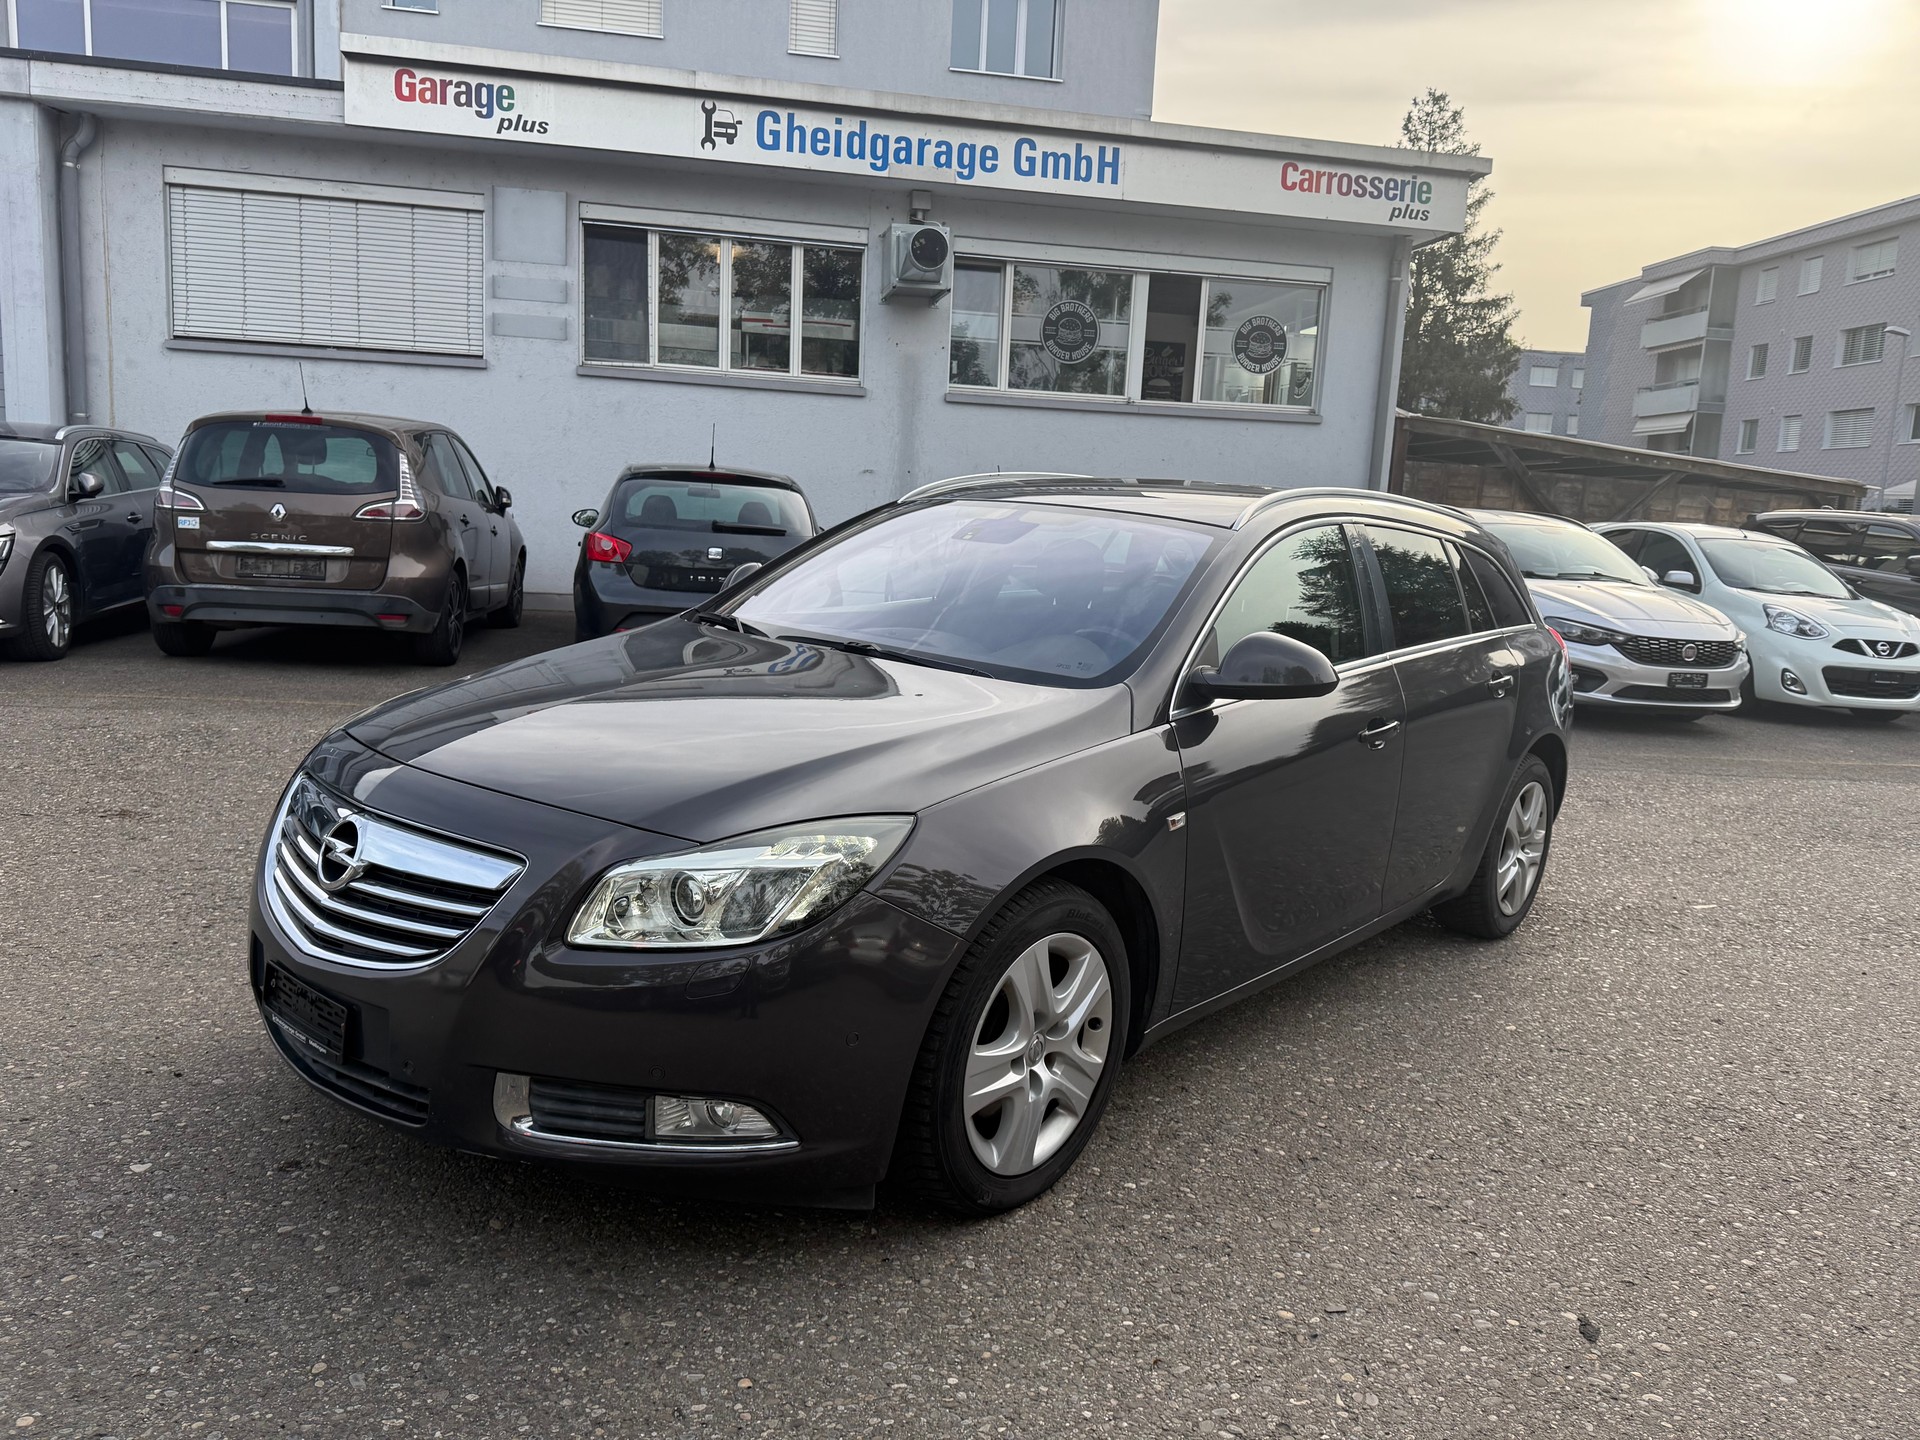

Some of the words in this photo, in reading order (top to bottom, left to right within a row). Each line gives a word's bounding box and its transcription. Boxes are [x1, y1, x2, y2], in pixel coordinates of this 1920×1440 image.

[394, 68, 515, 119] Garage
[496, 113, 549, 135] plus
[757, 110, 999, 181] Gheidgarage
[1014, 137, 1121, 185] GmbH
[1281, 162, 1433, 205] Carrosserie
[1388, 204, 1431, 222] plus
[1048, 307, 1061, 321] BIG
[1060, 303, 1094, 323] BROTHERS
[1240, 321, 1252, 335] BIG
[1251, 317, 1284, 337] BROTHERS
[1046, 339, 1071, 360] BURGER
[1071, 342, 1093, 360] HOUSE
[1237, 352, 1261, 372] BURGER
[1261, 354, 1282, 372] HOUSE
[249, 532, 308, 542] SCENIC
